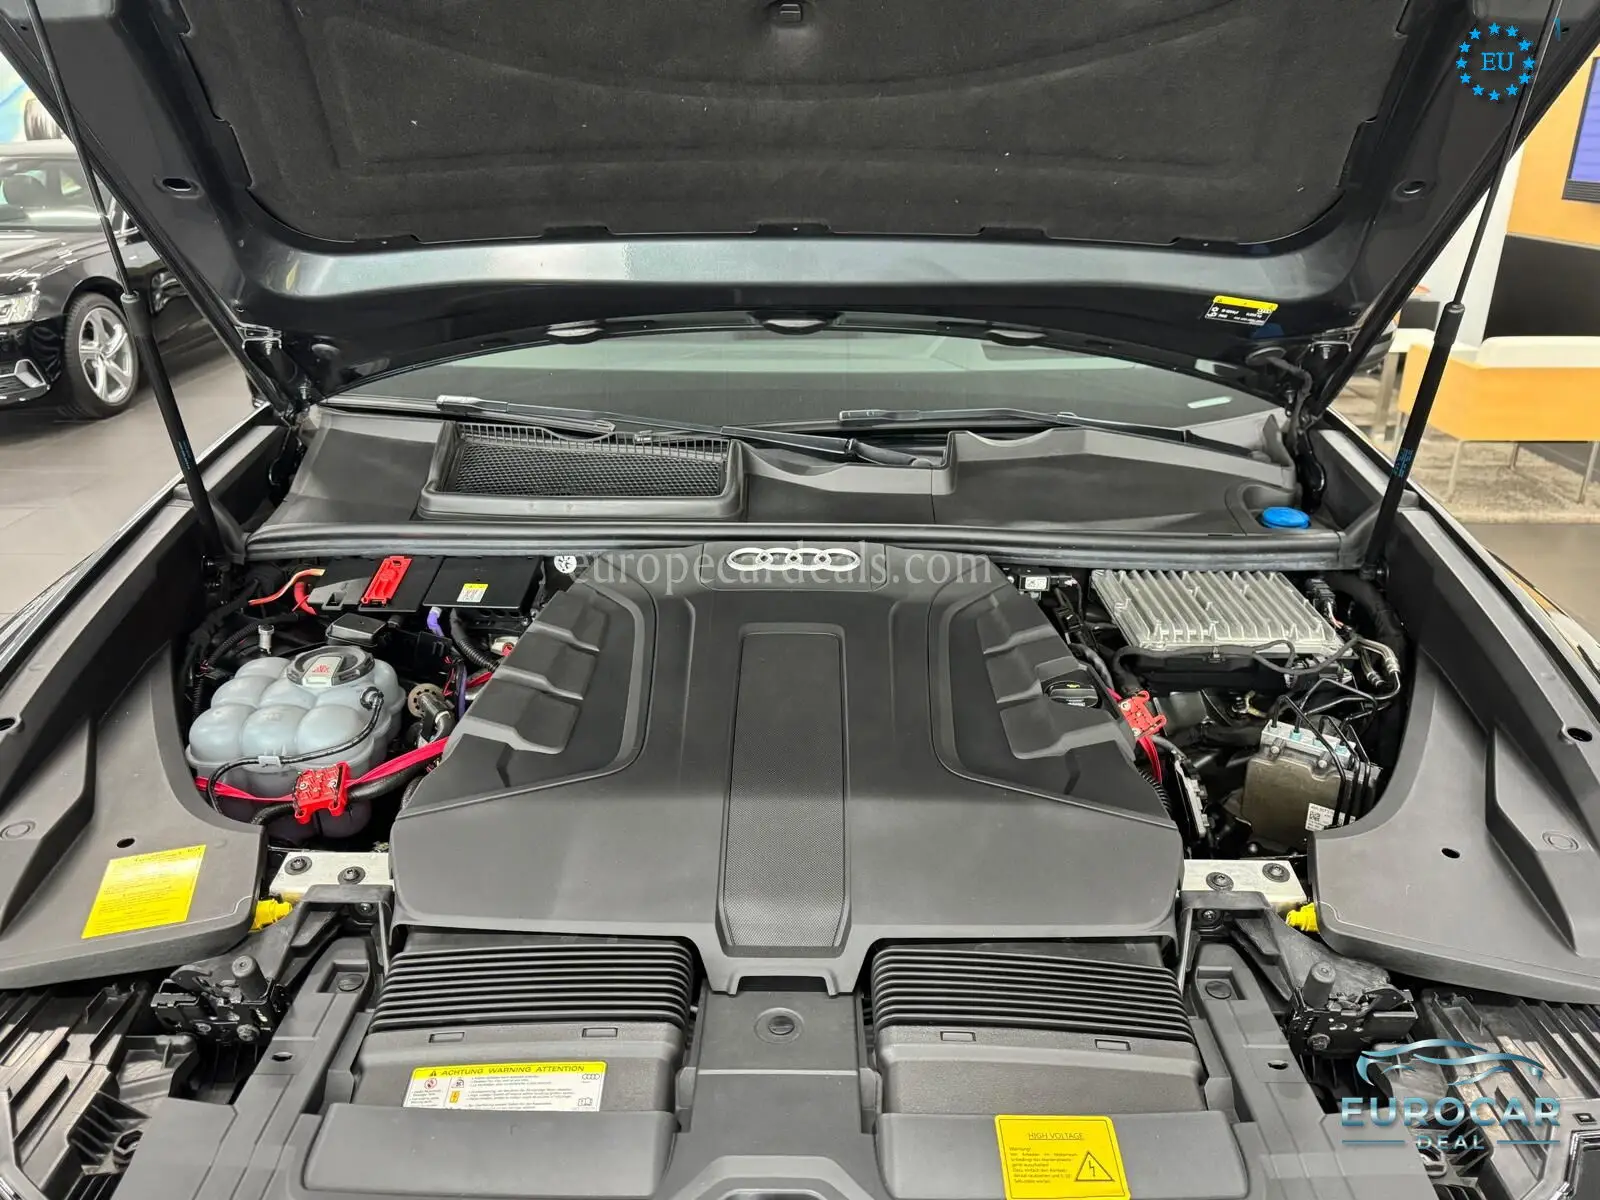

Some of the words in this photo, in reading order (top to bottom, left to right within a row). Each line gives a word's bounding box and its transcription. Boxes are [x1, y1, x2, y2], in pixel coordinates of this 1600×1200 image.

[441, 1068, 484, 1076] ACHTUNG
[488, 1066, 532, 1074] WARNING
[1028, 1131, 1048, 1140] HIGH
[1050, 1131, 1085, 1140] VOLTAGE
